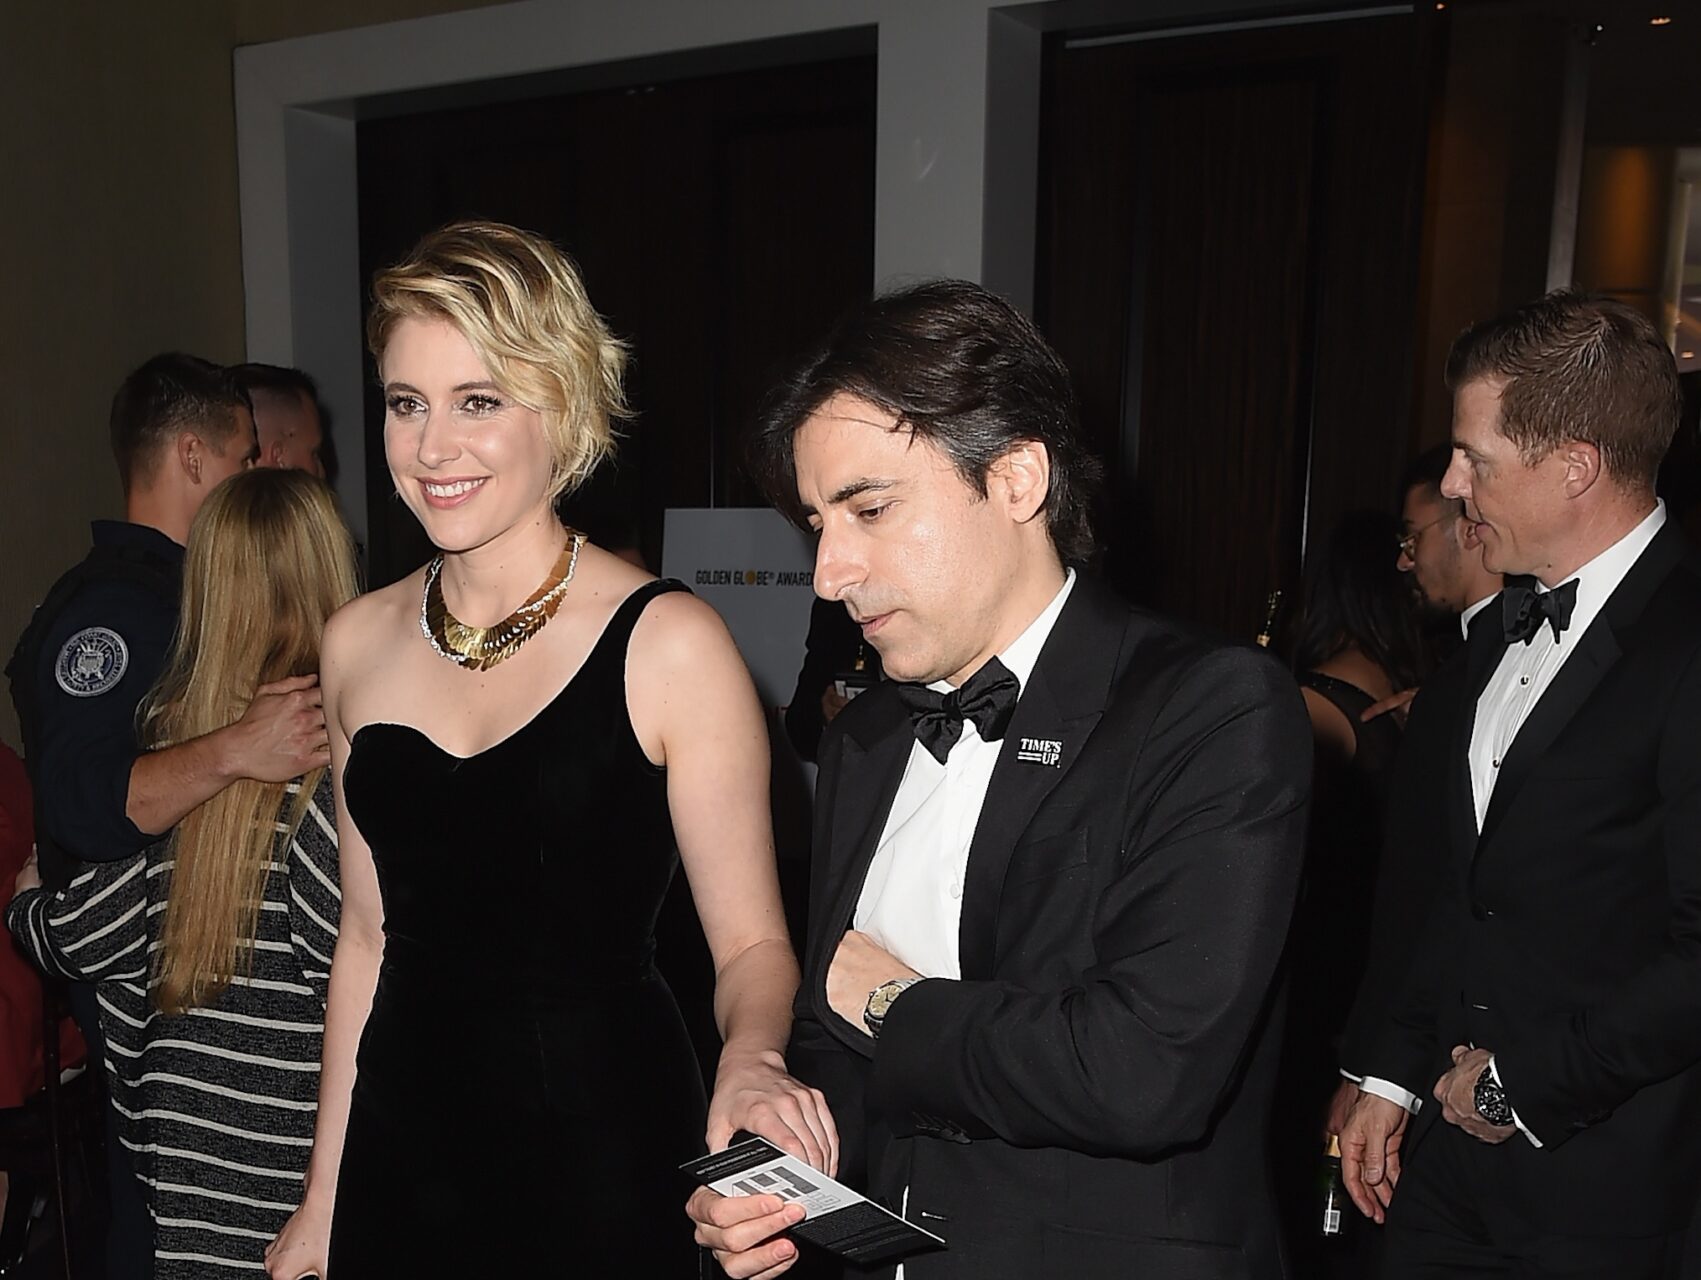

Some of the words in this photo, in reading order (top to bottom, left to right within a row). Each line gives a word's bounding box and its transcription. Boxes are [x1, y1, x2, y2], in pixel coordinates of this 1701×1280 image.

[696, 570, 731, 585] GOLDEN
[776, 571, 814, 586] AWARD
[1020, 738, 1062, 753] TIME'S
